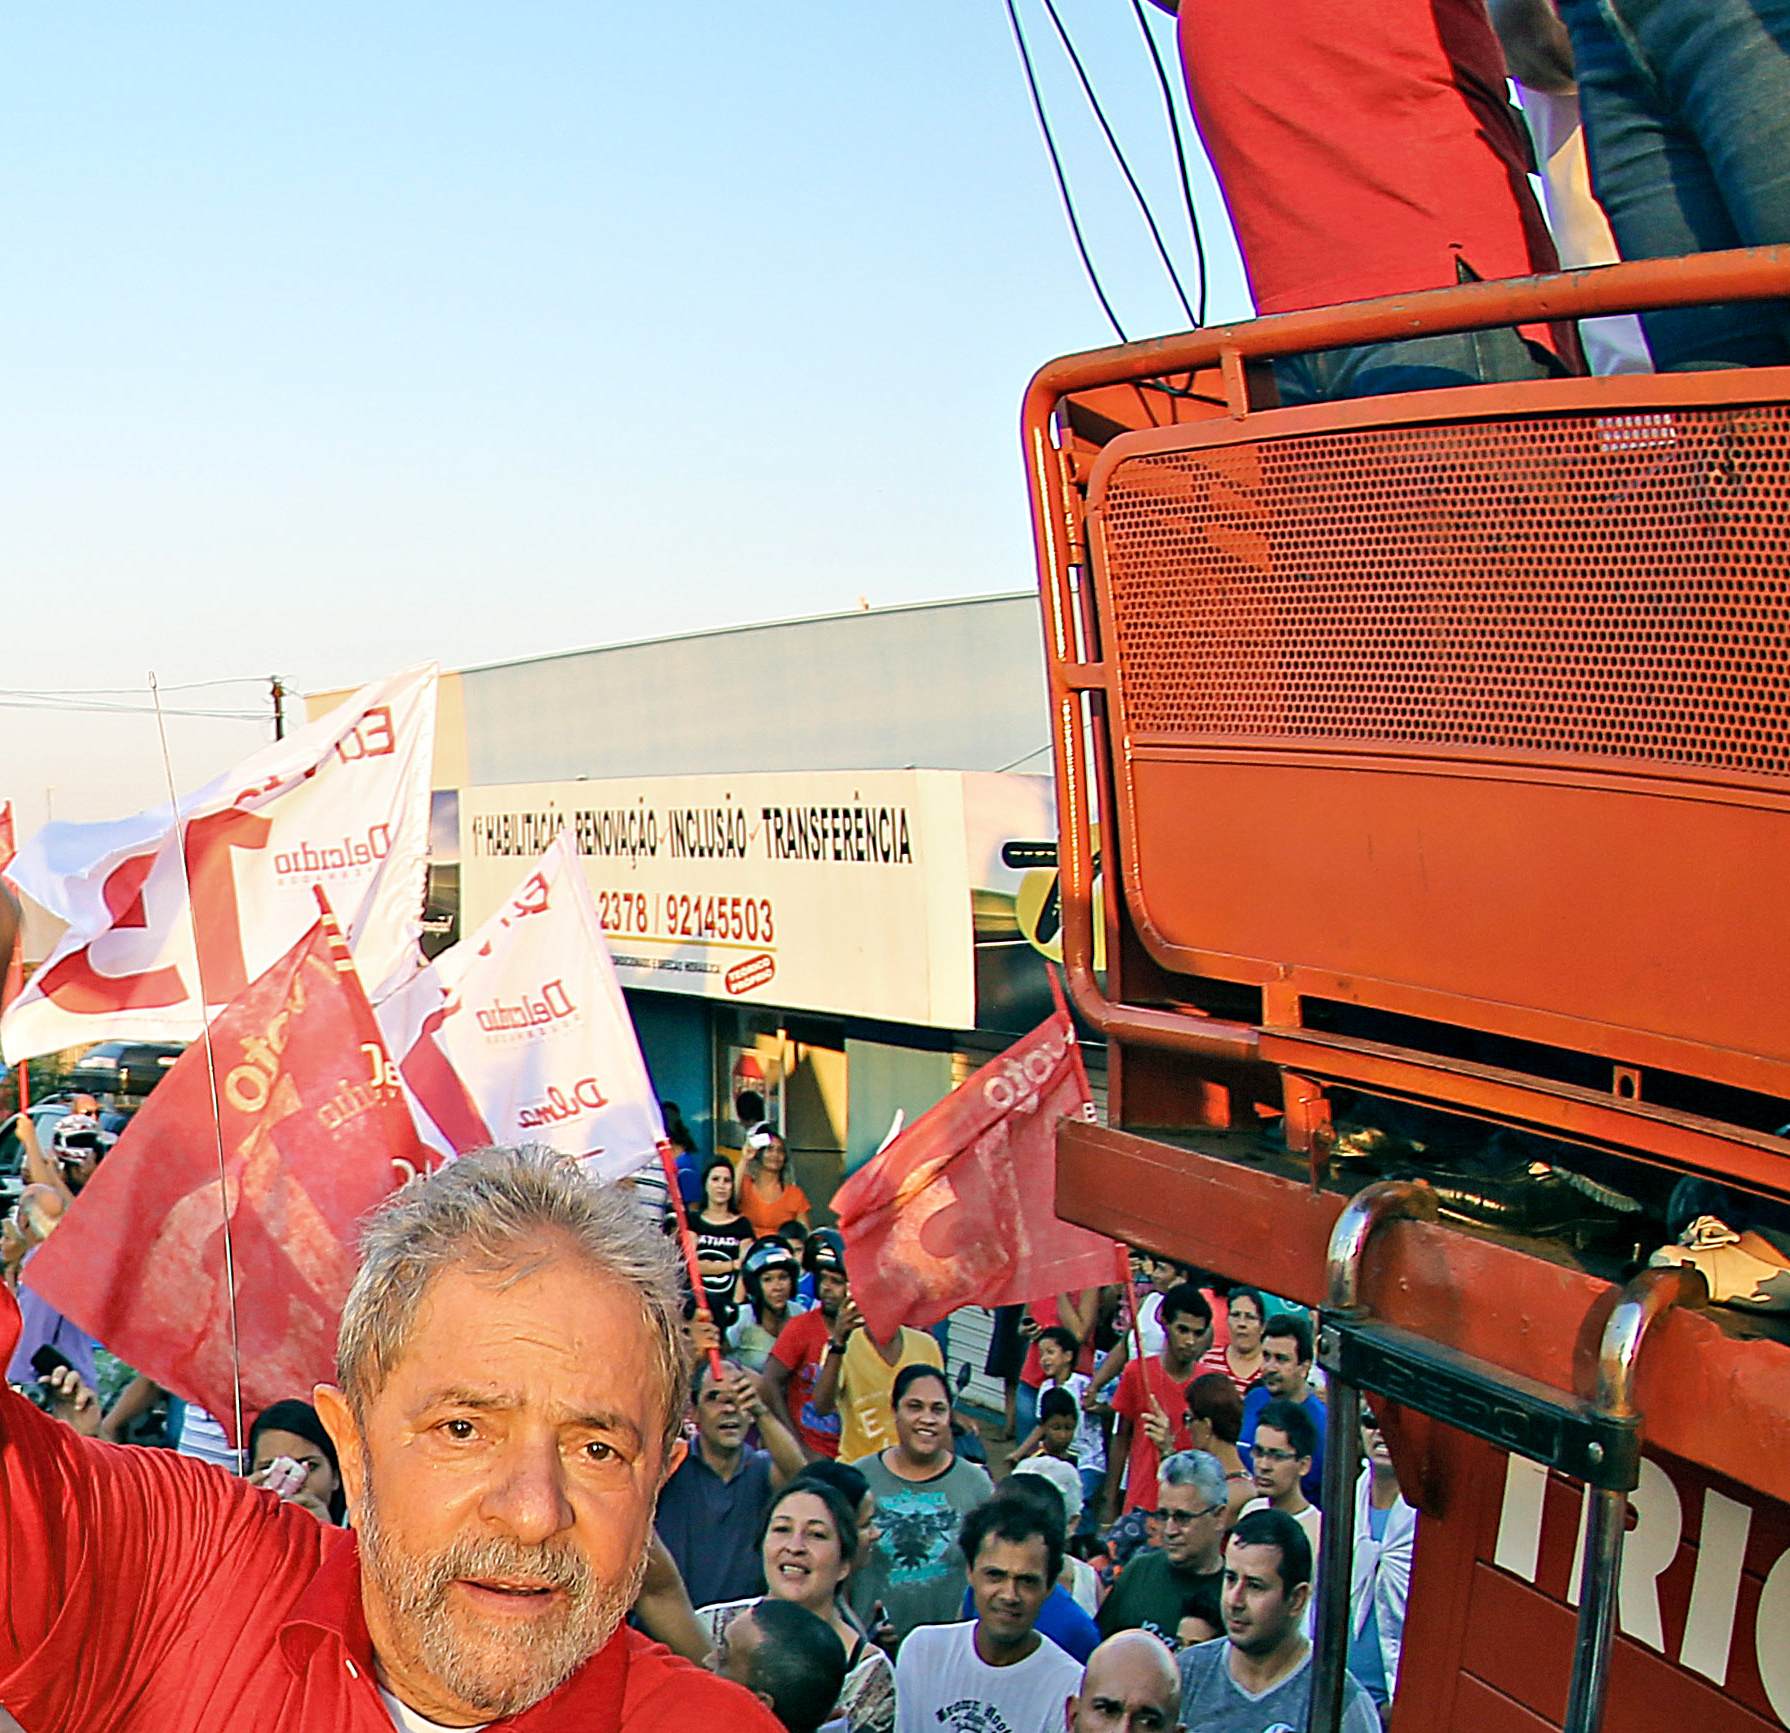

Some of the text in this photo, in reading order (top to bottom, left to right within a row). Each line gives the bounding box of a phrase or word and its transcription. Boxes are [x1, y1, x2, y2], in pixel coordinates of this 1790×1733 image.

[574, 795, 658, 870] RENOVAÇÃO
[669, 792, 748, 859] INCLUSÃO
[761, 790, 914, 865] TRANSFERÊNCIA
[666, 896, 775, 943] 92145503
